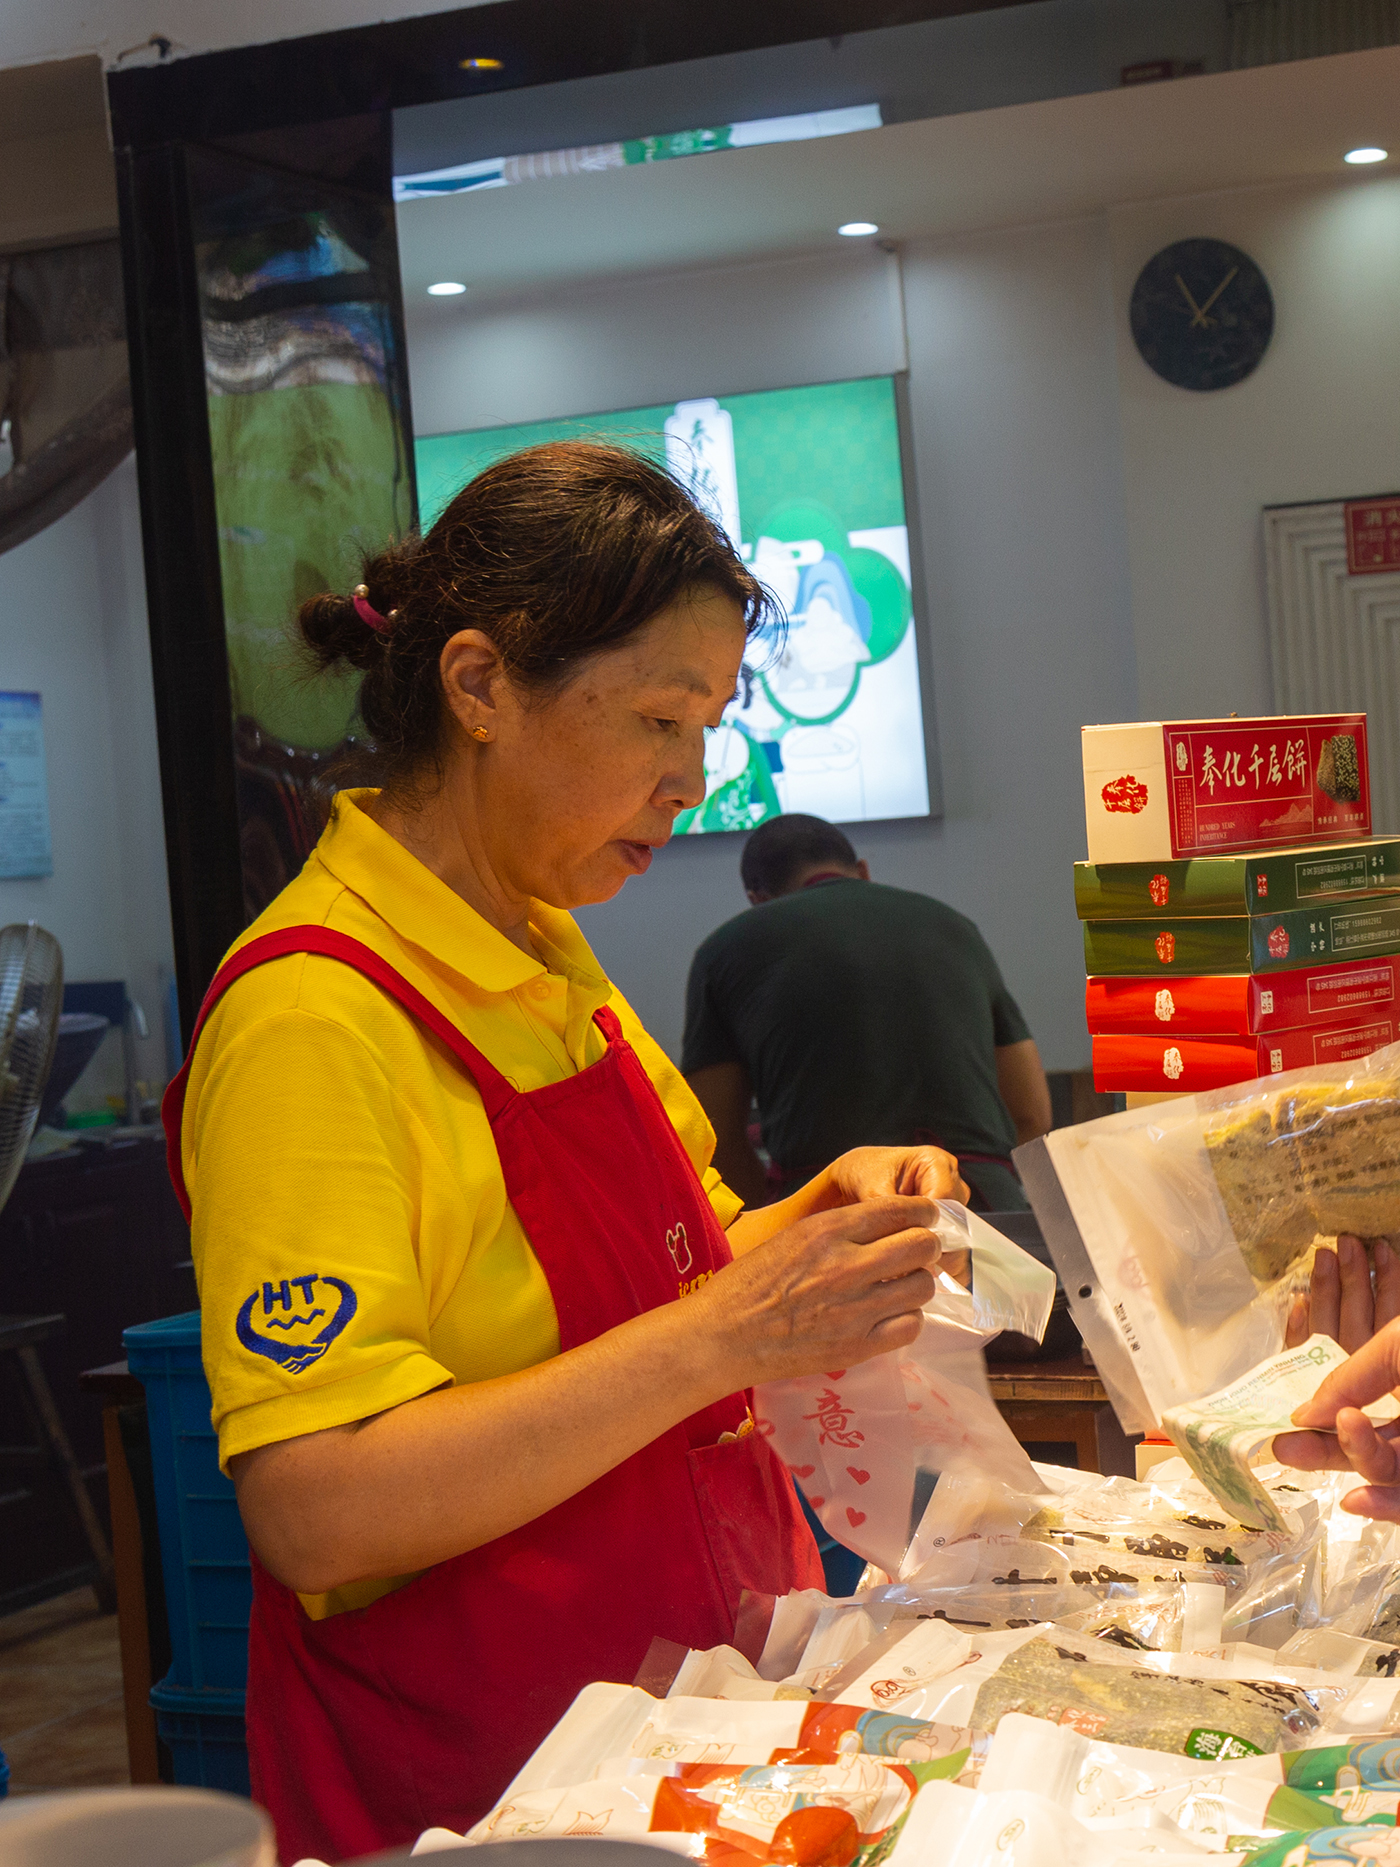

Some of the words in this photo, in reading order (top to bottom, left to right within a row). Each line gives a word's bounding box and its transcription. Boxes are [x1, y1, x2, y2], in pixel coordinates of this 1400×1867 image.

[263, 1273, 319, 1315] HT
[1306, 1344, 1331, 1368] 50
[803, 1388, 865, 1449] 意
